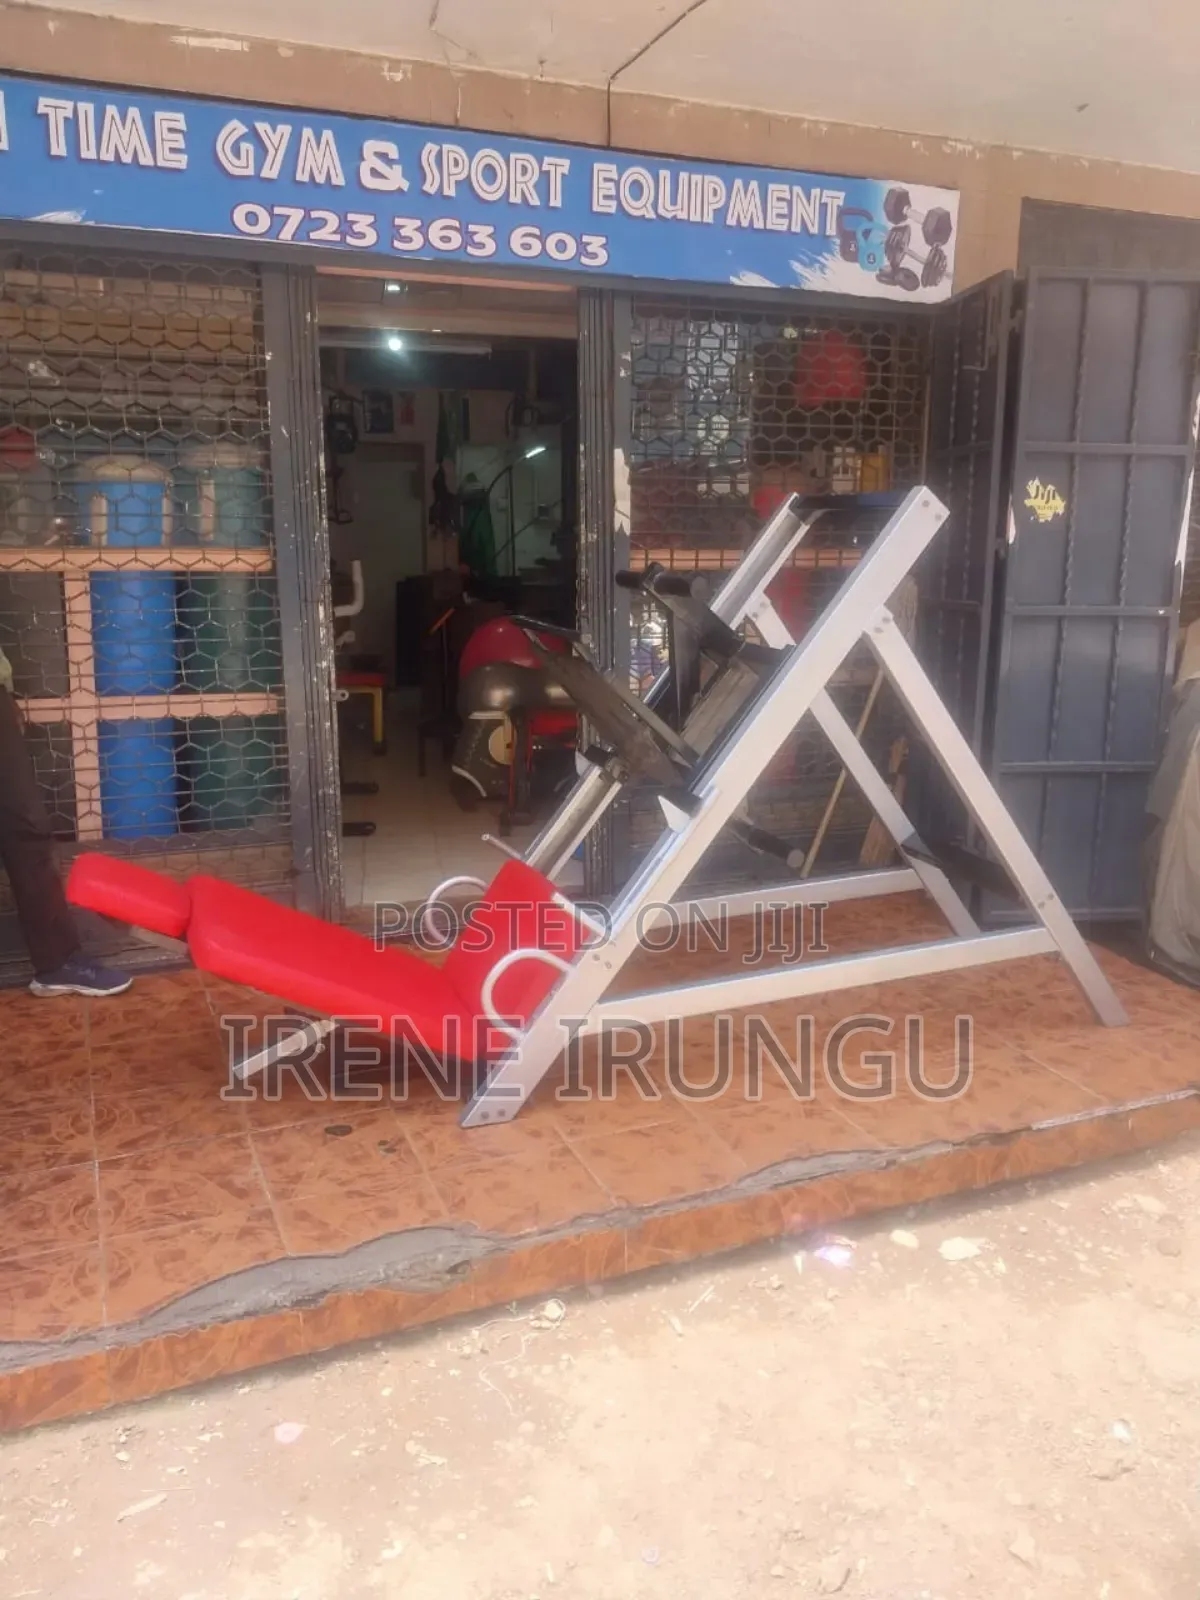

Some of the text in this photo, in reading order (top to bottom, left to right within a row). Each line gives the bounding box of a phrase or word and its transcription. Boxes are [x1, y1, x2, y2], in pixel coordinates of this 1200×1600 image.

[37, 96, 188, 169] TIME
[215, 119, 345, 187] GYM
[359, 139, 409, 192] &
[421, 142, 570, 207] SPORT
[591, 163, 846, 238] EQUIPMENT
[232, 203, 609, 266] 0723 363 603
